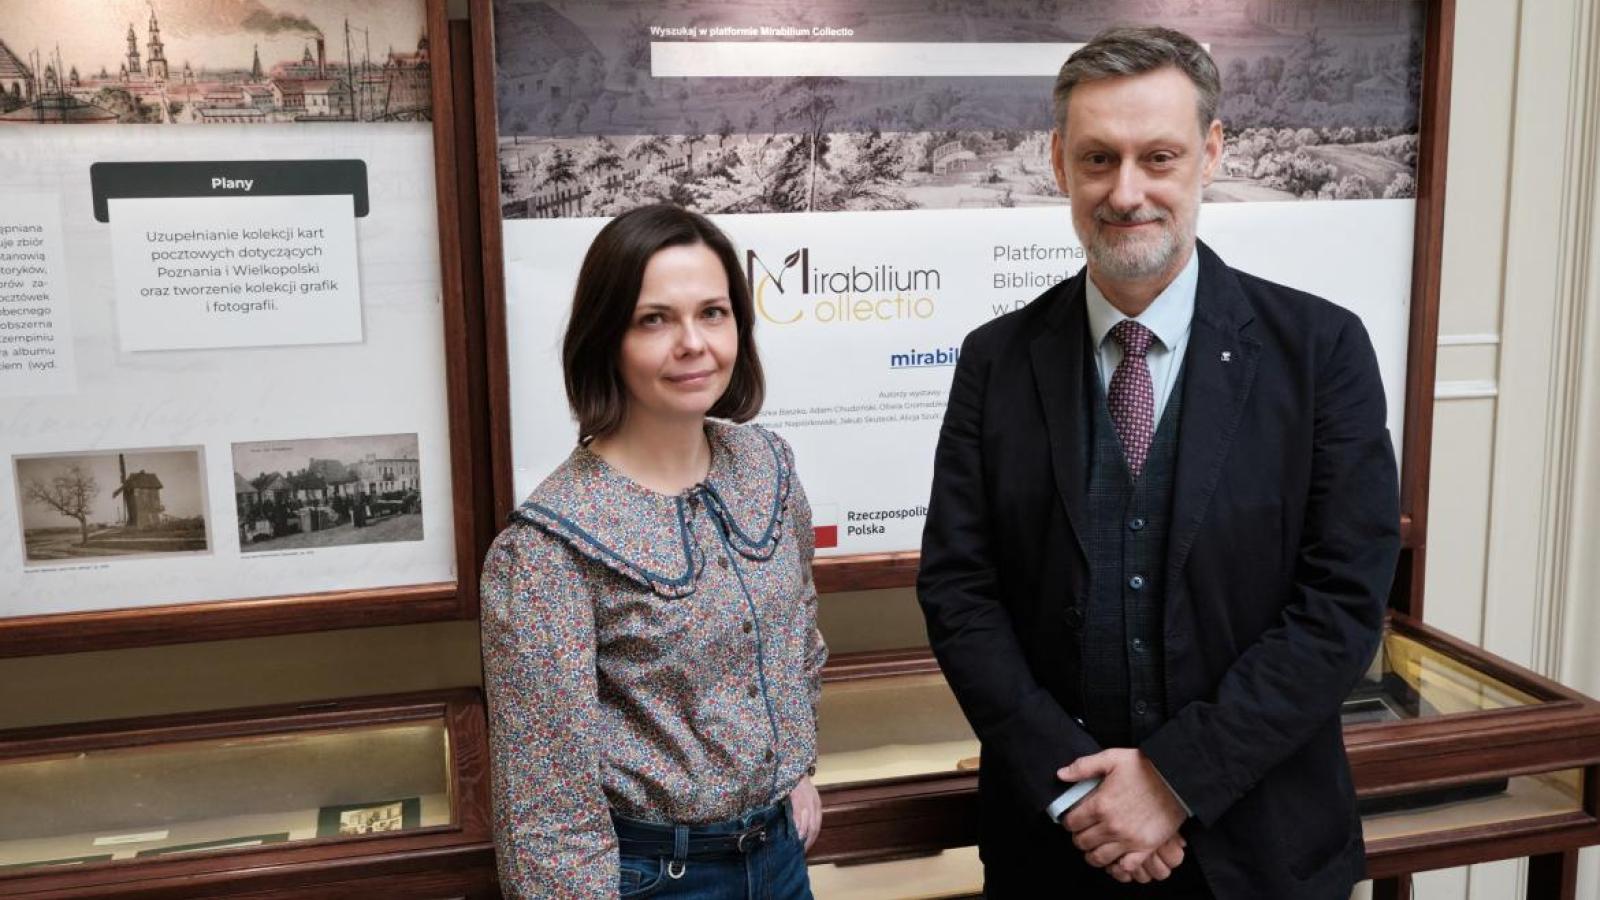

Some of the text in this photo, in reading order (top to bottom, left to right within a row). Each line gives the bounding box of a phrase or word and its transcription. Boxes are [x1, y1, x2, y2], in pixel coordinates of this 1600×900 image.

[651, 25, 854, 37] Wyszukaj w platformie Mirabilium Collectio
[211, 177, 253, 191] Plany
[146, 227, 324, 244] Uzupełnianie kolekcji kart
[151, 246, 322, 262] pocztowych dotyczących
[993, 244, 1084, 261] Platforma
[158, 263, 320, 279] Poznania i Wielkopolski
[747, 247, 941, 294] Mirabilium
[993, 269, 1073, 289] Bibliote
[140, 280, 338, 297] oraz tworzenie kolekcji grafik
[756, 270, 935, 325] Collectio
[213, 299, 278, 315] fotografii.
[992, 303, 1009, 316] w
[848, 524, 885, 536] Polska
